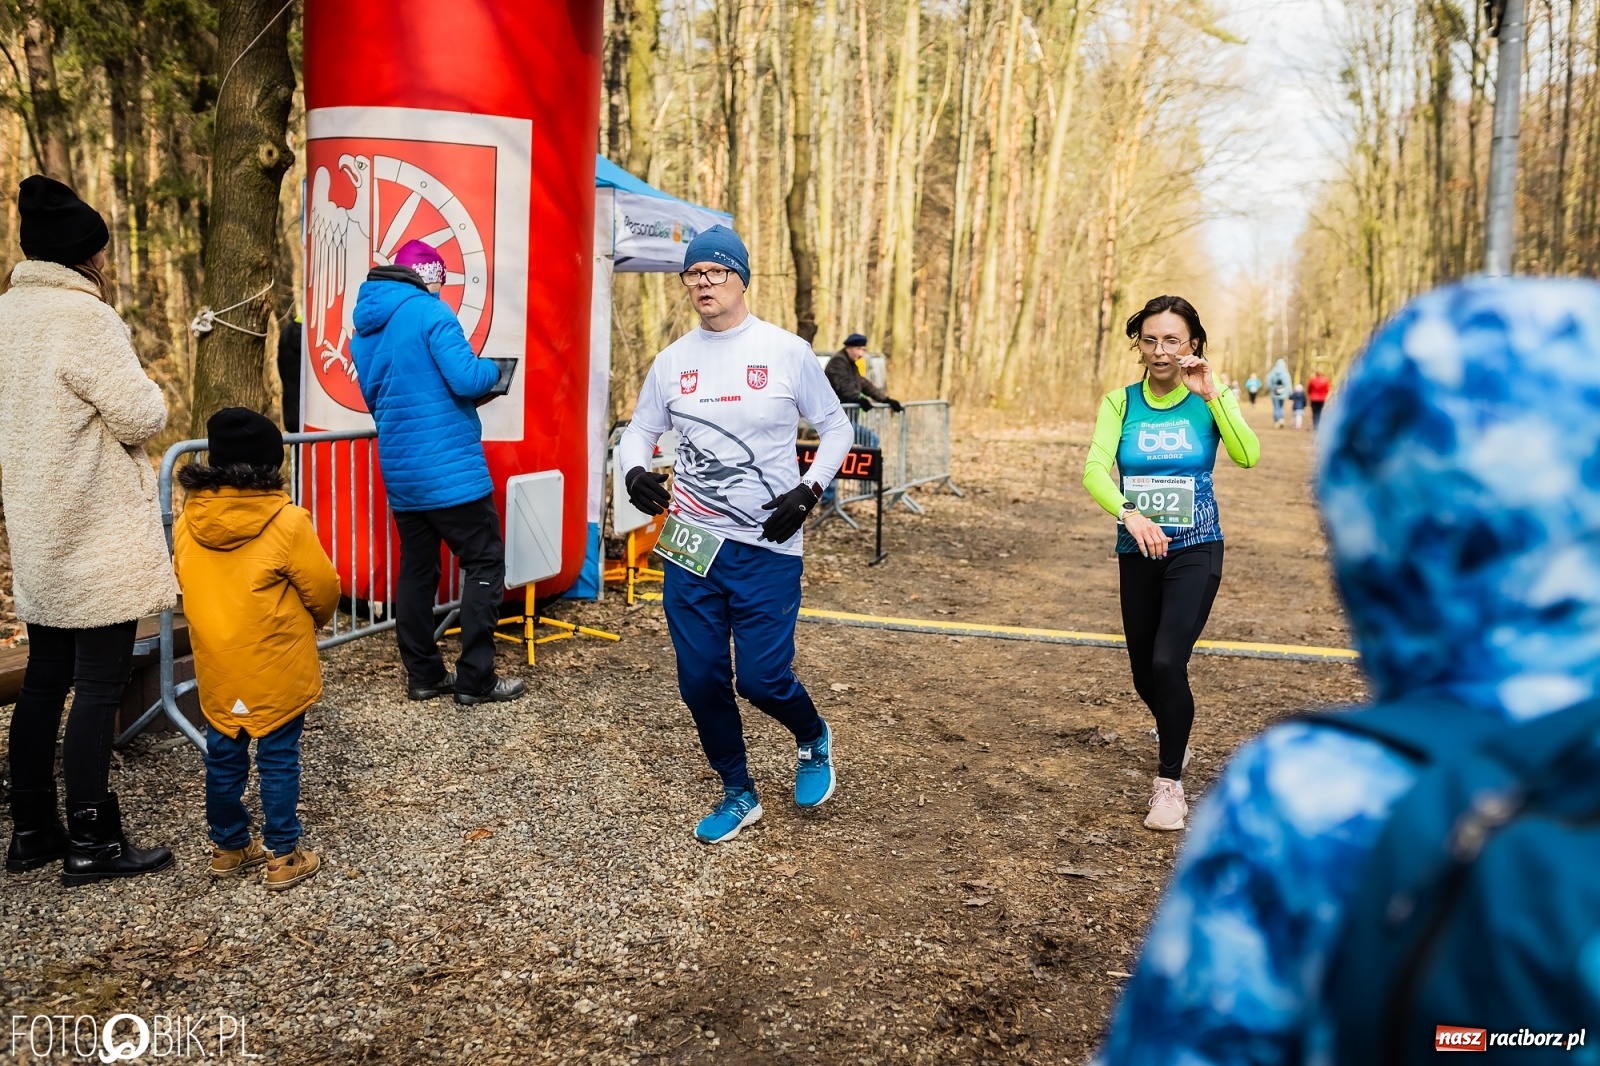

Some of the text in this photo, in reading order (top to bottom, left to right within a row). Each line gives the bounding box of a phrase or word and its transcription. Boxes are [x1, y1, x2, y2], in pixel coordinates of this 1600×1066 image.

[1138, 428, 1192, 452] bbl
[1147, 453, 1183, 461] RACIBÓRZ
[1137, 492, 1179, 511] 092
[670, 523, 703, 554] 103
